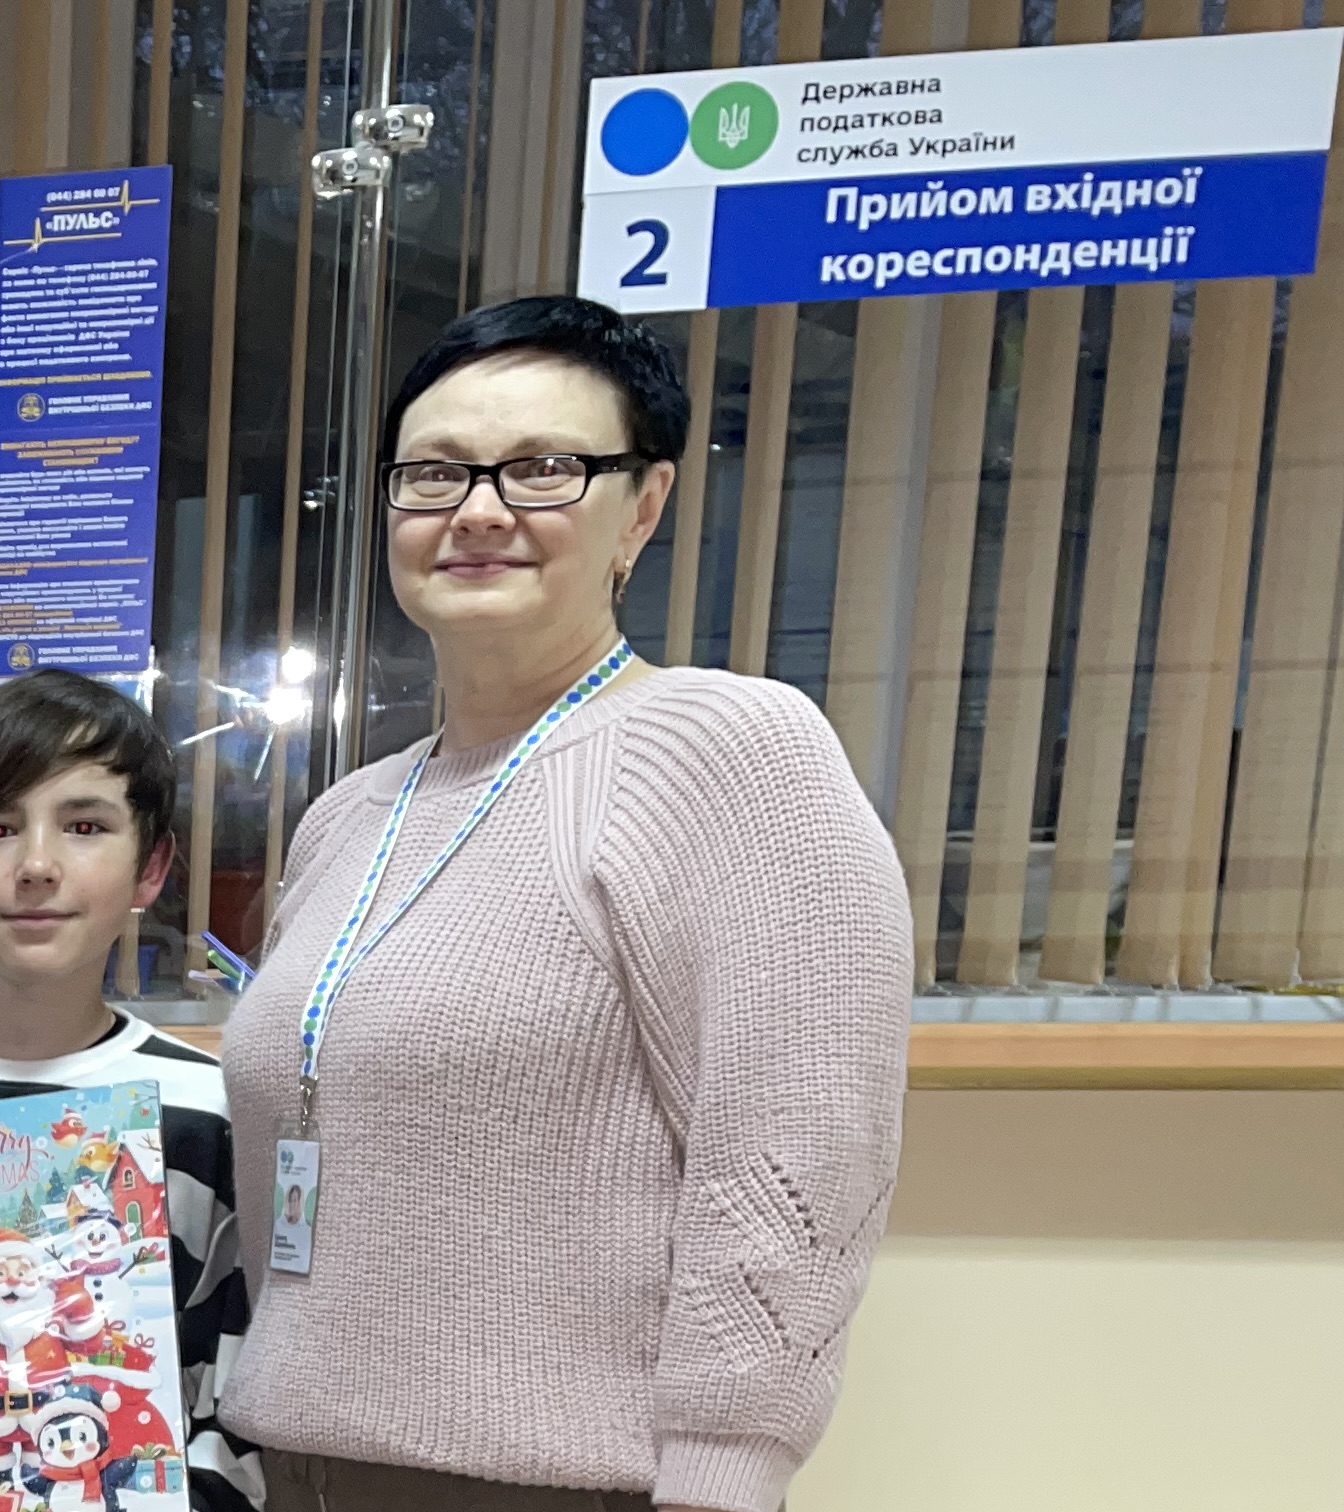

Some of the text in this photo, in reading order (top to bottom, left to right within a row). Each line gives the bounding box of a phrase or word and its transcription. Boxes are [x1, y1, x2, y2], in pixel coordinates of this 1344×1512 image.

[802, 74, 942, 106] Державна
[799, 107, 944, 135] податкова
[797, 131, 1016, 164] служба України
[826, 166, 1203, 230] Прийом вхідної
[46, 210, 120, 232] «ПУЛЬС»
[619, 219, 670, 288] 2
[820, 226, 1196, 287] кореспонденції
